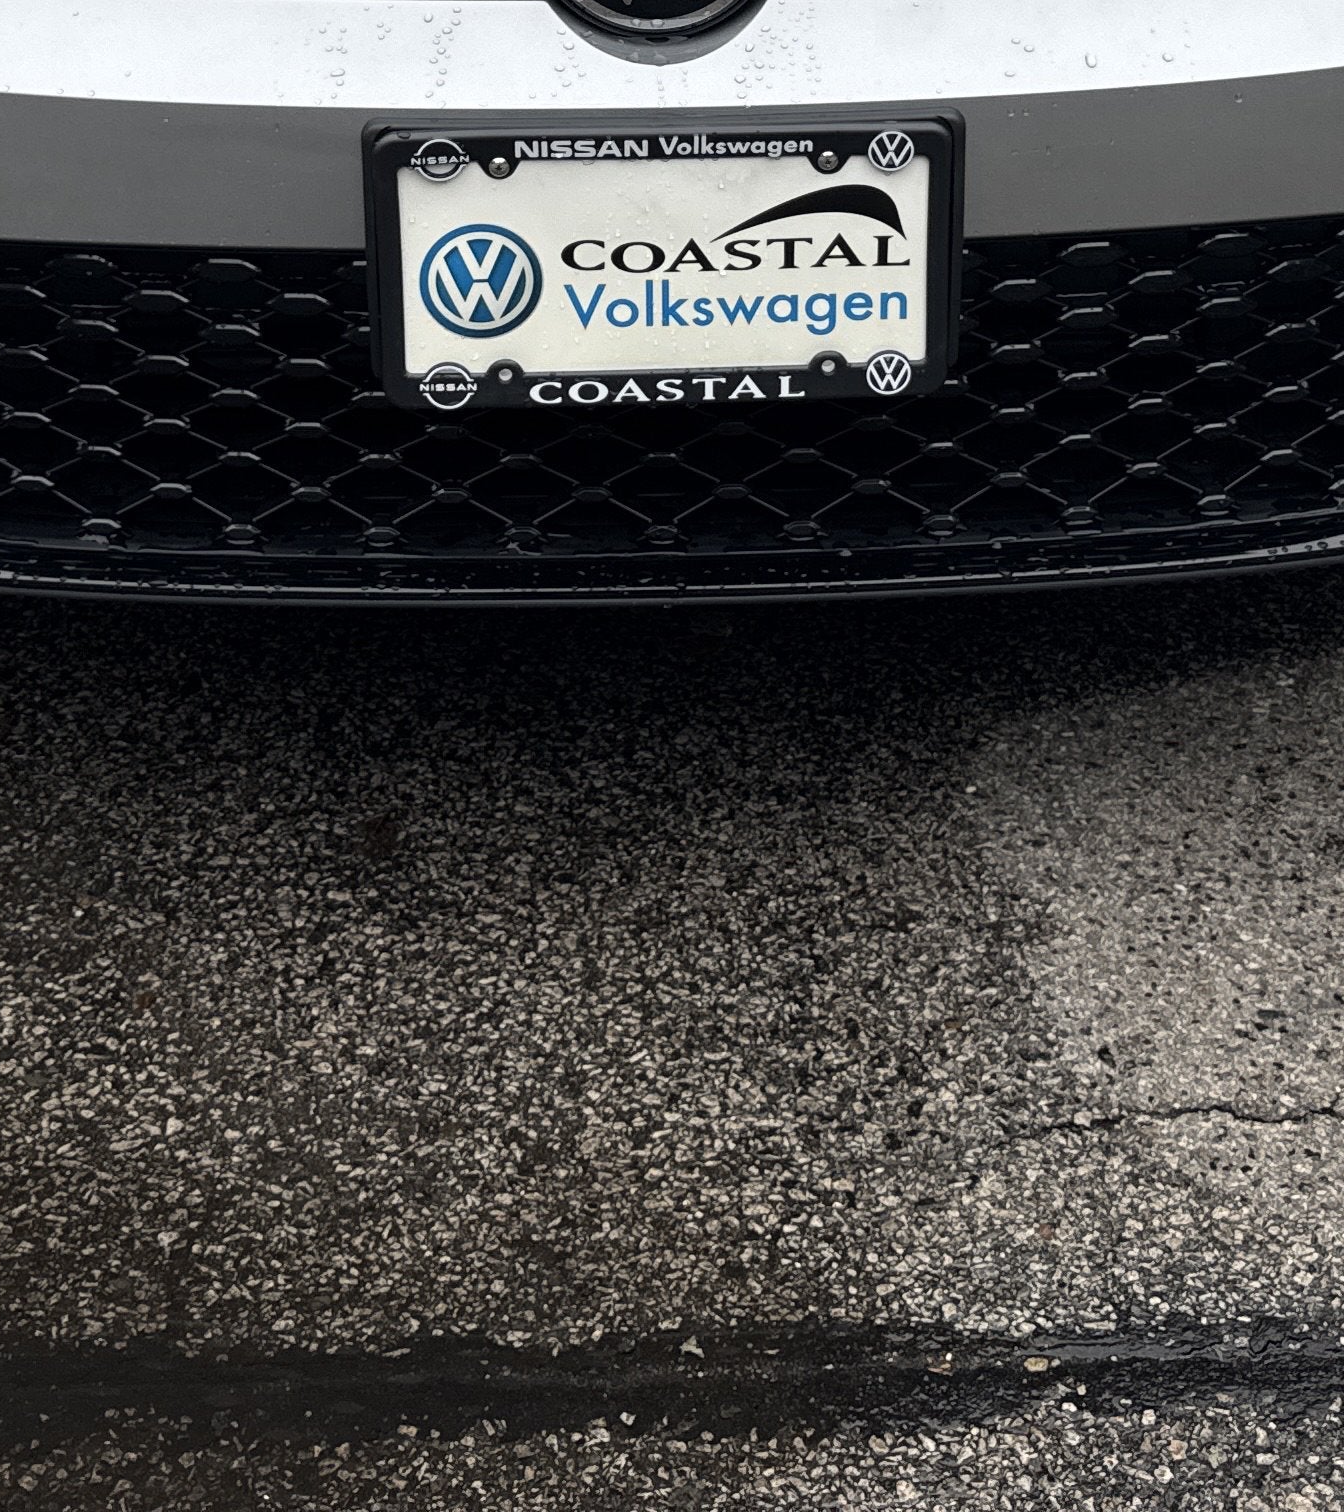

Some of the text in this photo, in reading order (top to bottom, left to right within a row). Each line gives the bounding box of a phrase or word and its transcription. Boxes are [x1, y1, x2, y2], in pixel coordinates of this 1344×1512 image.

[411, 154, 470, 166] NISSAN
[514, 135, 814, 159] NISSAN Volkswagen
[869, 132, 913, 170] VW
[560, 233, 911, 274] COASTAL
[428, 230, 533, 330] VW
[564, 279, 908, 336] Volkswagen
[419, 381, 478, 392] NISSAN
[529, 374, 805, 405] COASTAL
[868, 354, 911, 393] VW
